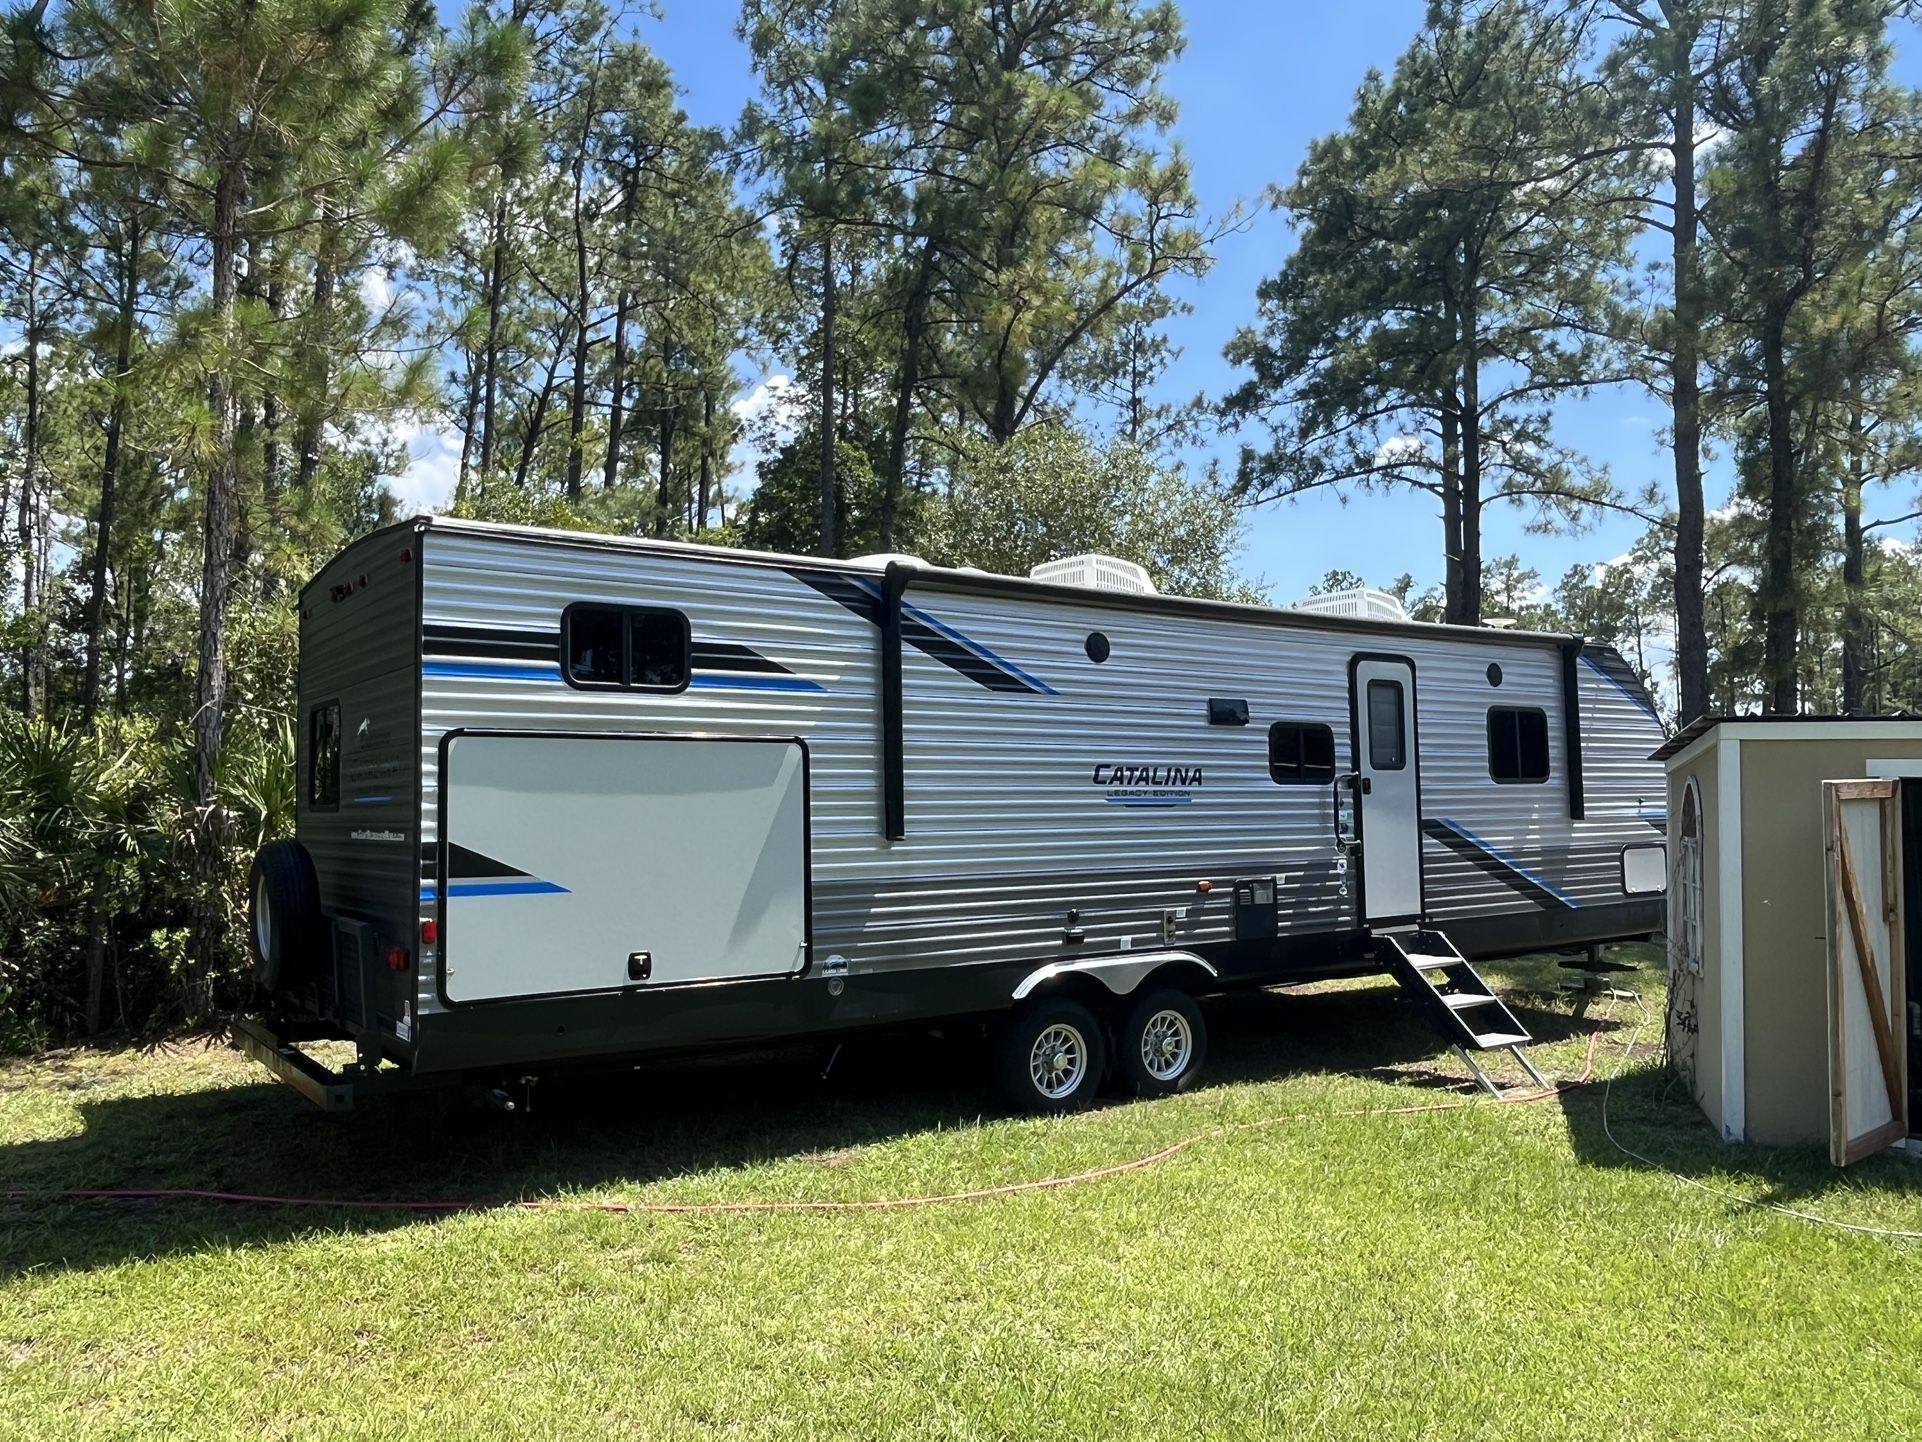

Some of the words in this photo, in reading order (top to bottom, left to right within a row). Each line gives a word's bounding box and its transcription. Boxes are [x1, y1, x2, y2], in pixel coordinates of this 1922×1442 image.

[1092, 764, 1202, 786] CATALINA
[1106, 789, 1148, 797] LEGACY
[1152, 789, 1191, 797] EDITION
